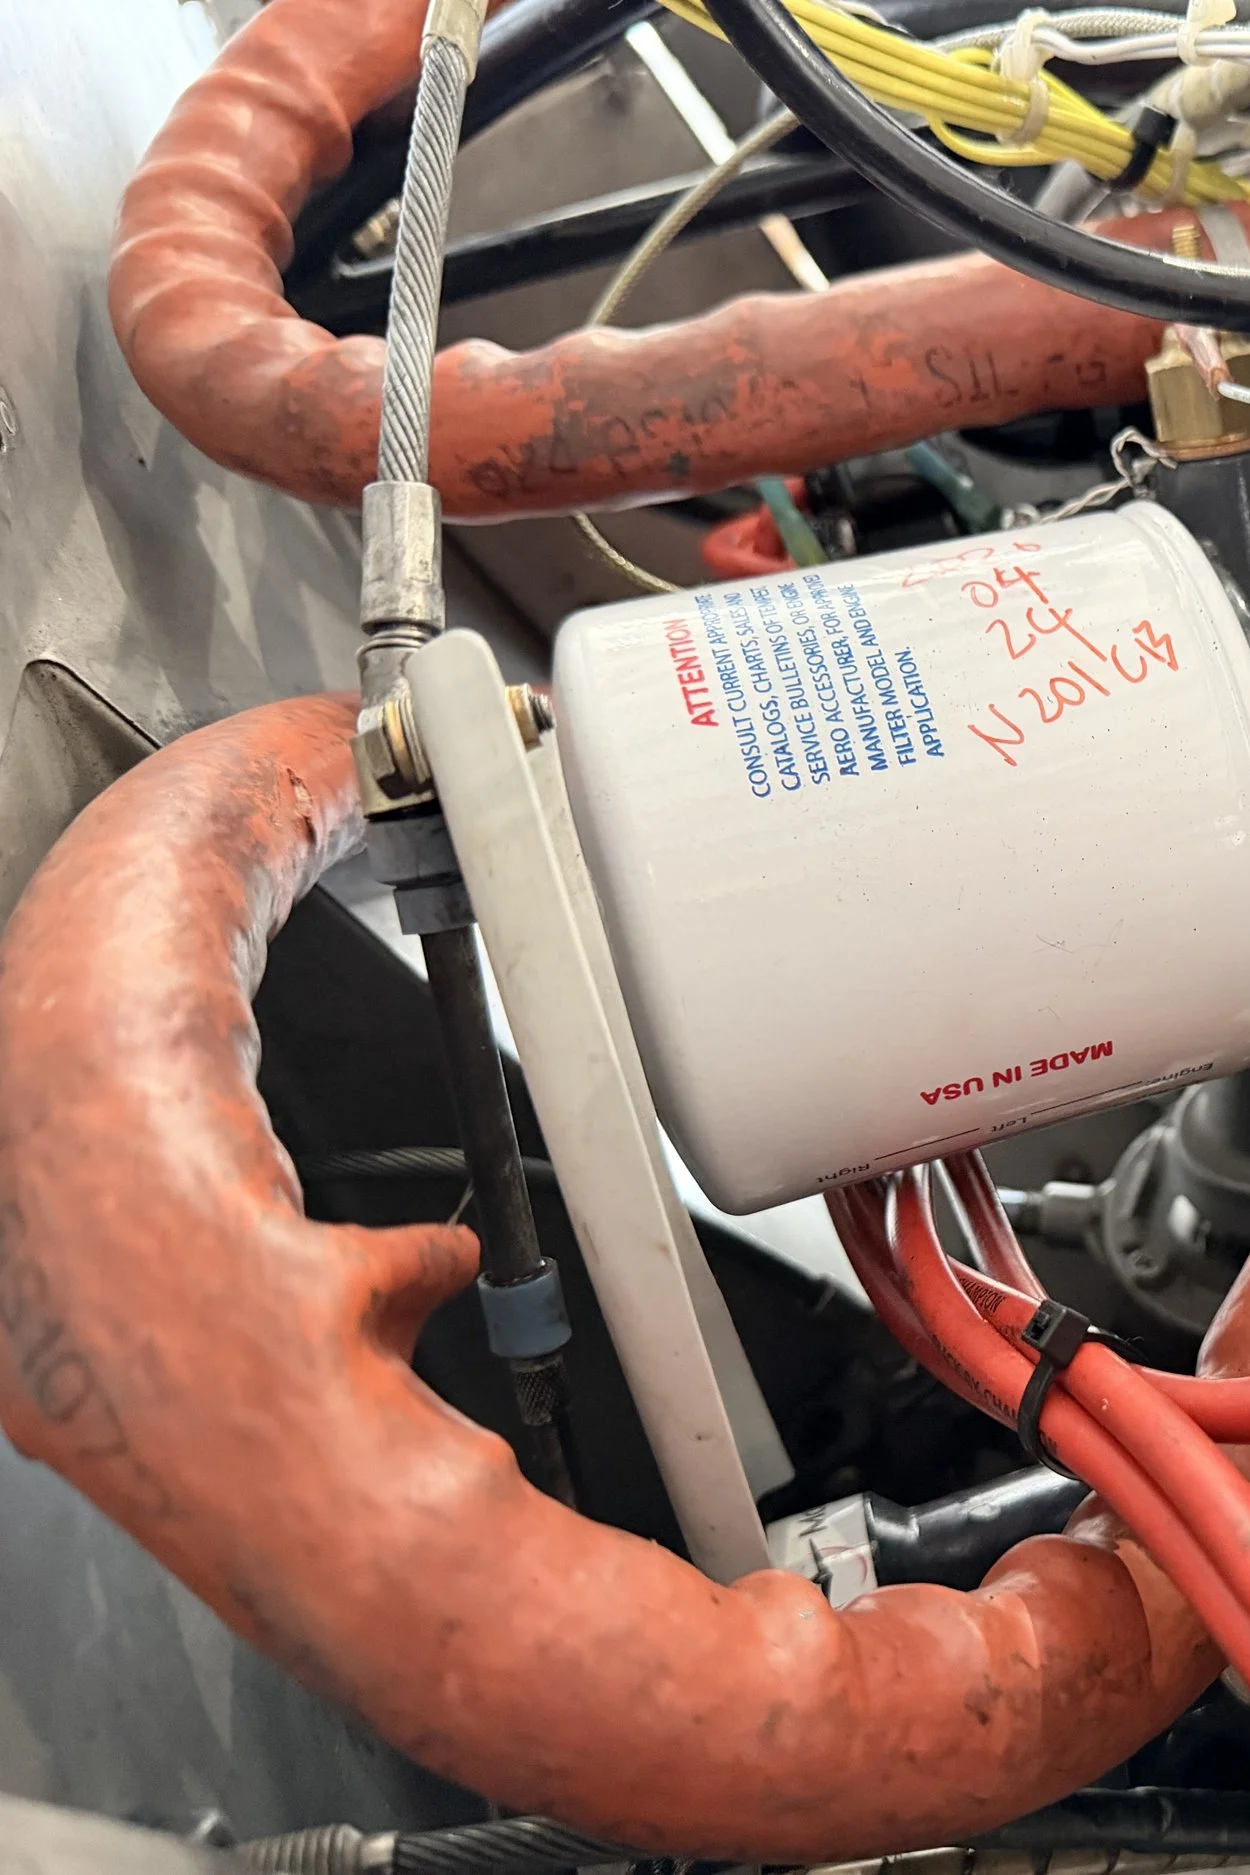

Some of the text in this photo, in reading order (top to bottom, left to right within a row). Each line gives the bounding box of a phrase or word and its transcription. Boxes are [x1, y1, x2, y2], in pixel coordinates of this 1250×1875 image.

[961, 566, 1049, 609] 04
[762, 616, 784, 634] OF
[662, 618, 719, 727] ATTENTION
[711, 648, 748, 711] CURRENT
[723, 591, 801, 791] CATALOGS, CHARTS, SALES AND
[769, 636, 810, 710] BULLETINS
[777, 581, 860, 776] AERO ACCESSORIES, OR ENGINE
[802, 573, 888, 771] MANUFACTURER, FOR APPROVED
[836, 583, 917, 767] FILTER MODEL AND ENGINE
[894, 646, 945, 757] APPLICATION.
[732, 715, 771, 798] CONSULT
[795, 711, 831, 785] SERVICE
[919, 1040, 1114, 1106] MADE IN USA
[990, 1115, 1028, 1133] Left
[814, 1161, 871, 1185] Right
